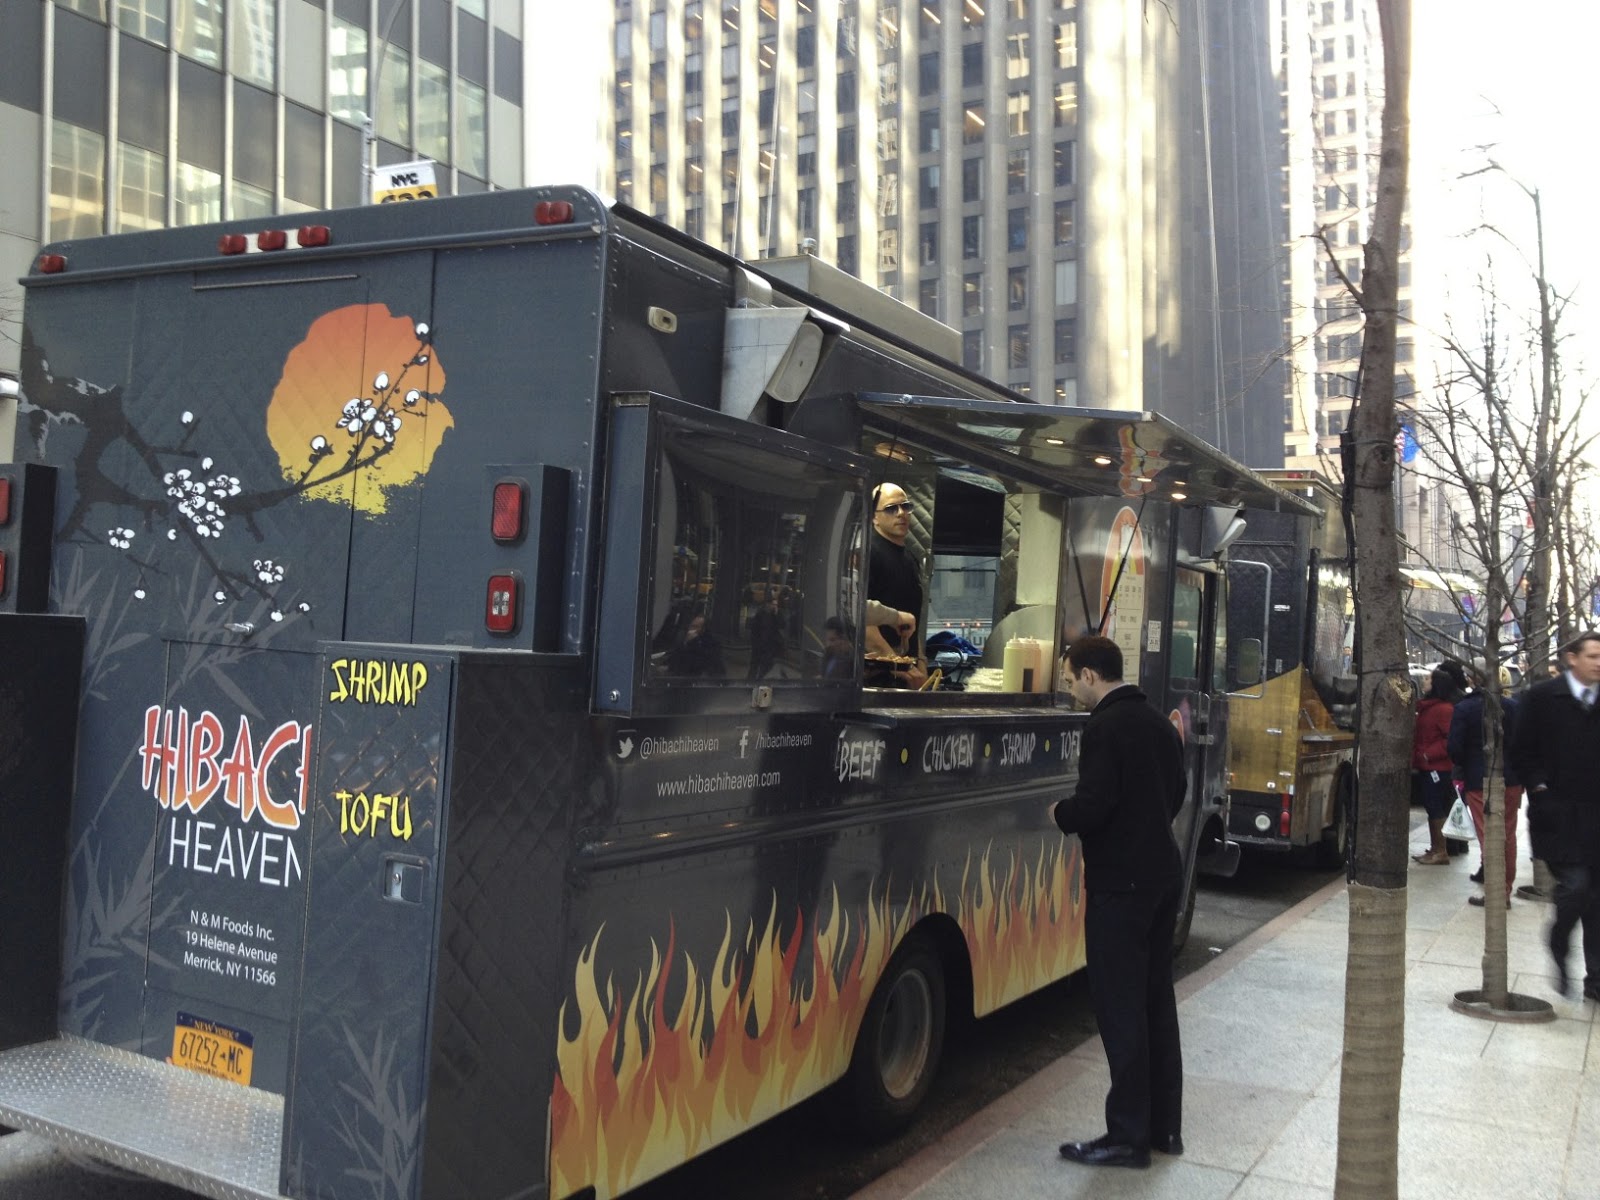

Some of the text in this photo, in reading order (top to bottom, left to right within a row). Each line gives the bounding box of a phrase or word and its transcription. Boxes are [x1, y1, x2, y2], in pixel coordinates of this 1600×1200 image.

[391, 172, 419, 188] NYC
[329, 658, 428, 707] SHRIMP
[639, 736, 720, 760] @hibachiheaven
[838, 738, 886, 783] BEEF
[922, 732, 975, 773] CHICKEN
[1000, 731, 1037, 767] SHRIMP
[656, 771, 781, 798] www.hibachiheaven.com
[335, 789, 413, 842] TOFU
[190, 909, 275, 941] N & M Foods Inc.
[186, 930, 278, 964] 19 Helene Avenue
[183, 950, 276, 986] Merrick, NY 11566
[194, 1019, 212, 1034] NEW
